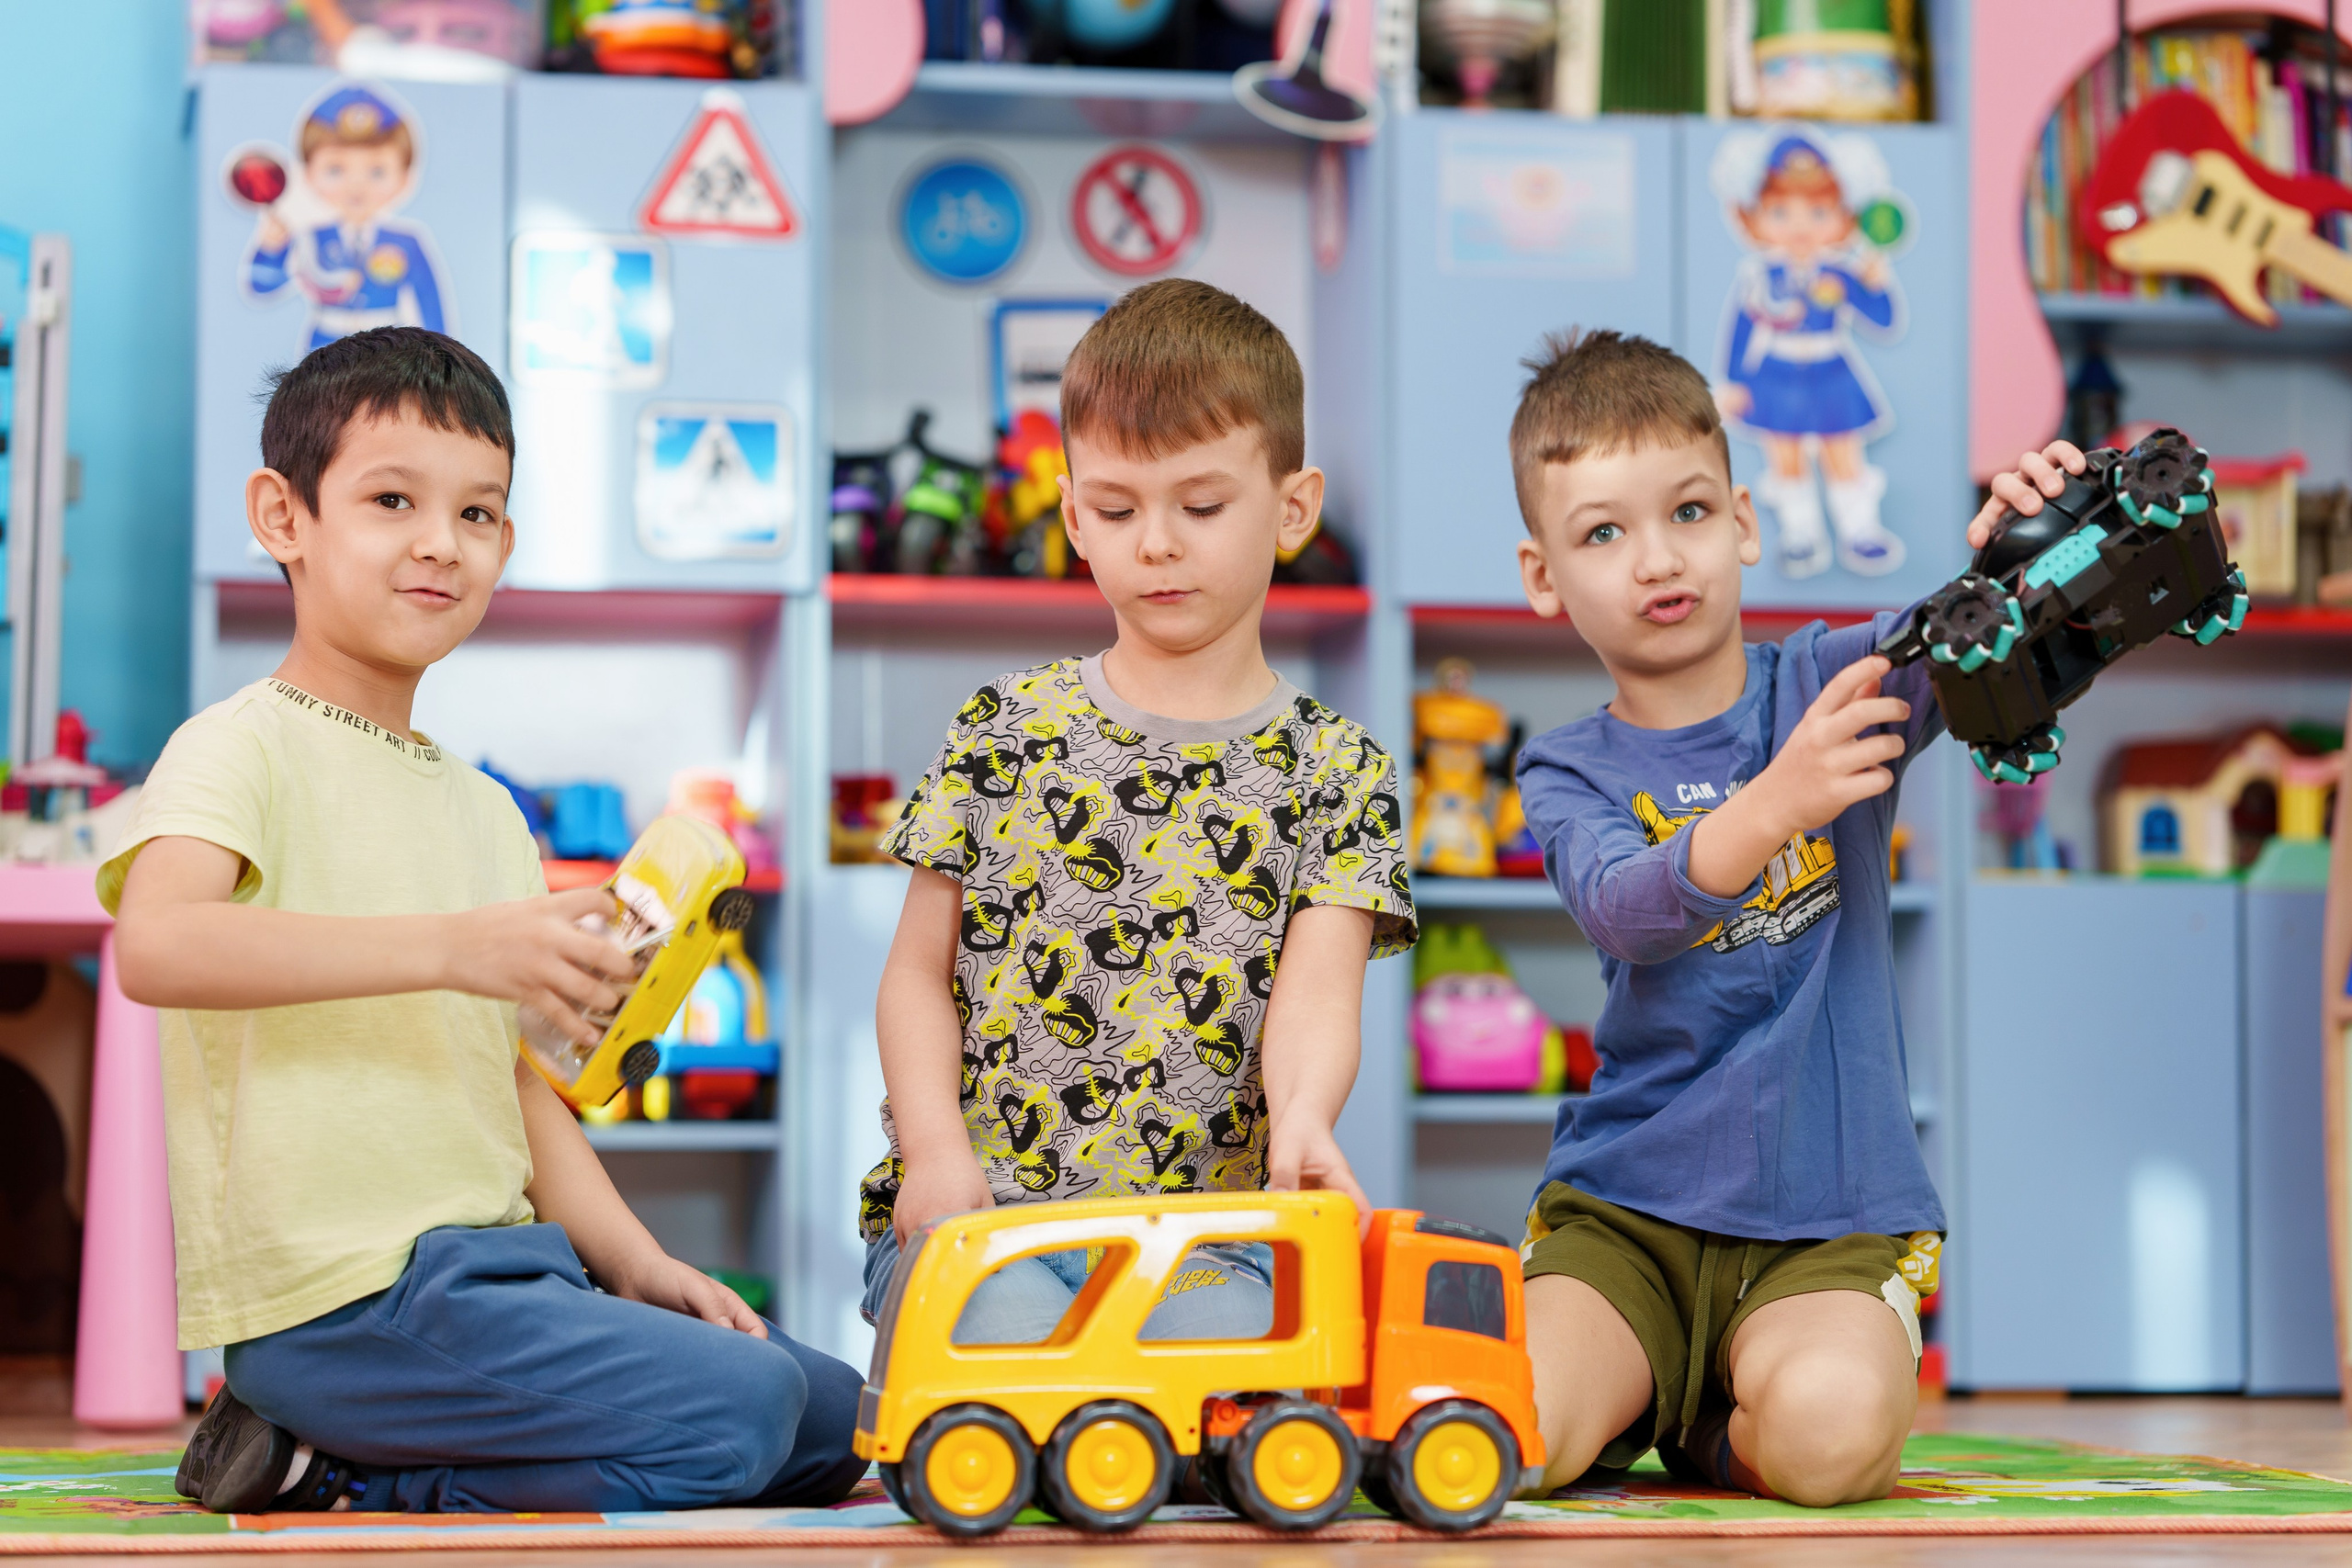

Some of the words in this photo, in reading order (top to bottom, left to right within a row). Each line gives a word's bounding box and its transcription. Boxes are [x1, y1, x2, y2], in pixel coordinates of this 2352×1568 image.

[322, 705, 380, 737] STREET
[385, 732, 406, 753] ART
[1676, 782, 1717, 805] CAN
[1169, 1269, 1223, 1288] TION
